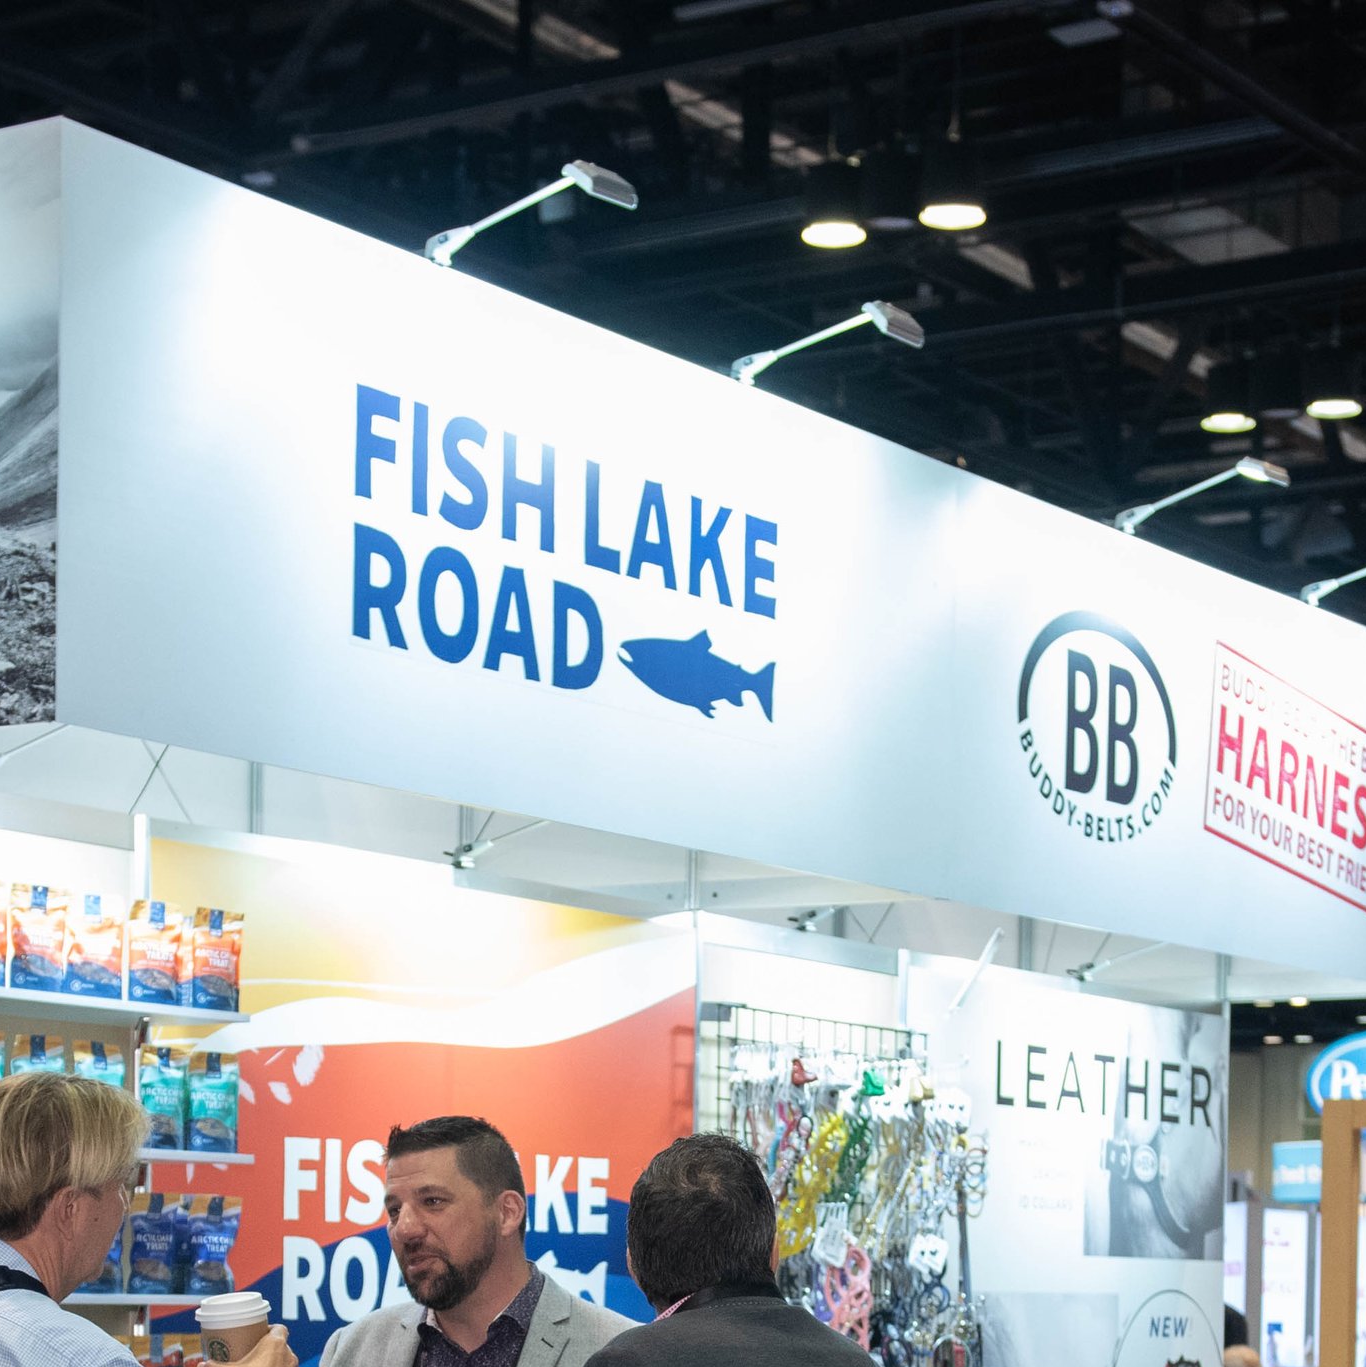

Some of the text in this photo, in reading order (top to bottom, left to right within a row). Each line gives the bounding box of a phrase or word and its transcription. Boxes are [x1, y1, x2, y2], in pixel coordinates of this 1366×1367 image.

[353, 382, 778, 620] FISH LAKE
[351, 520, 604, 691] ROAD
[1064, 647, 1139, 806] BB
[1019, 727, 1174, 843] BUDDY-BELTS.COM
[1212, 787, 1246, 831] FOR
[1249, 805, 1293, 855] YOUR
[1296, 831, 1333, 874] BEST
[995, 1038, 1215, 1129] LEATHER
[283, 1136, 387, 1225] FIS
